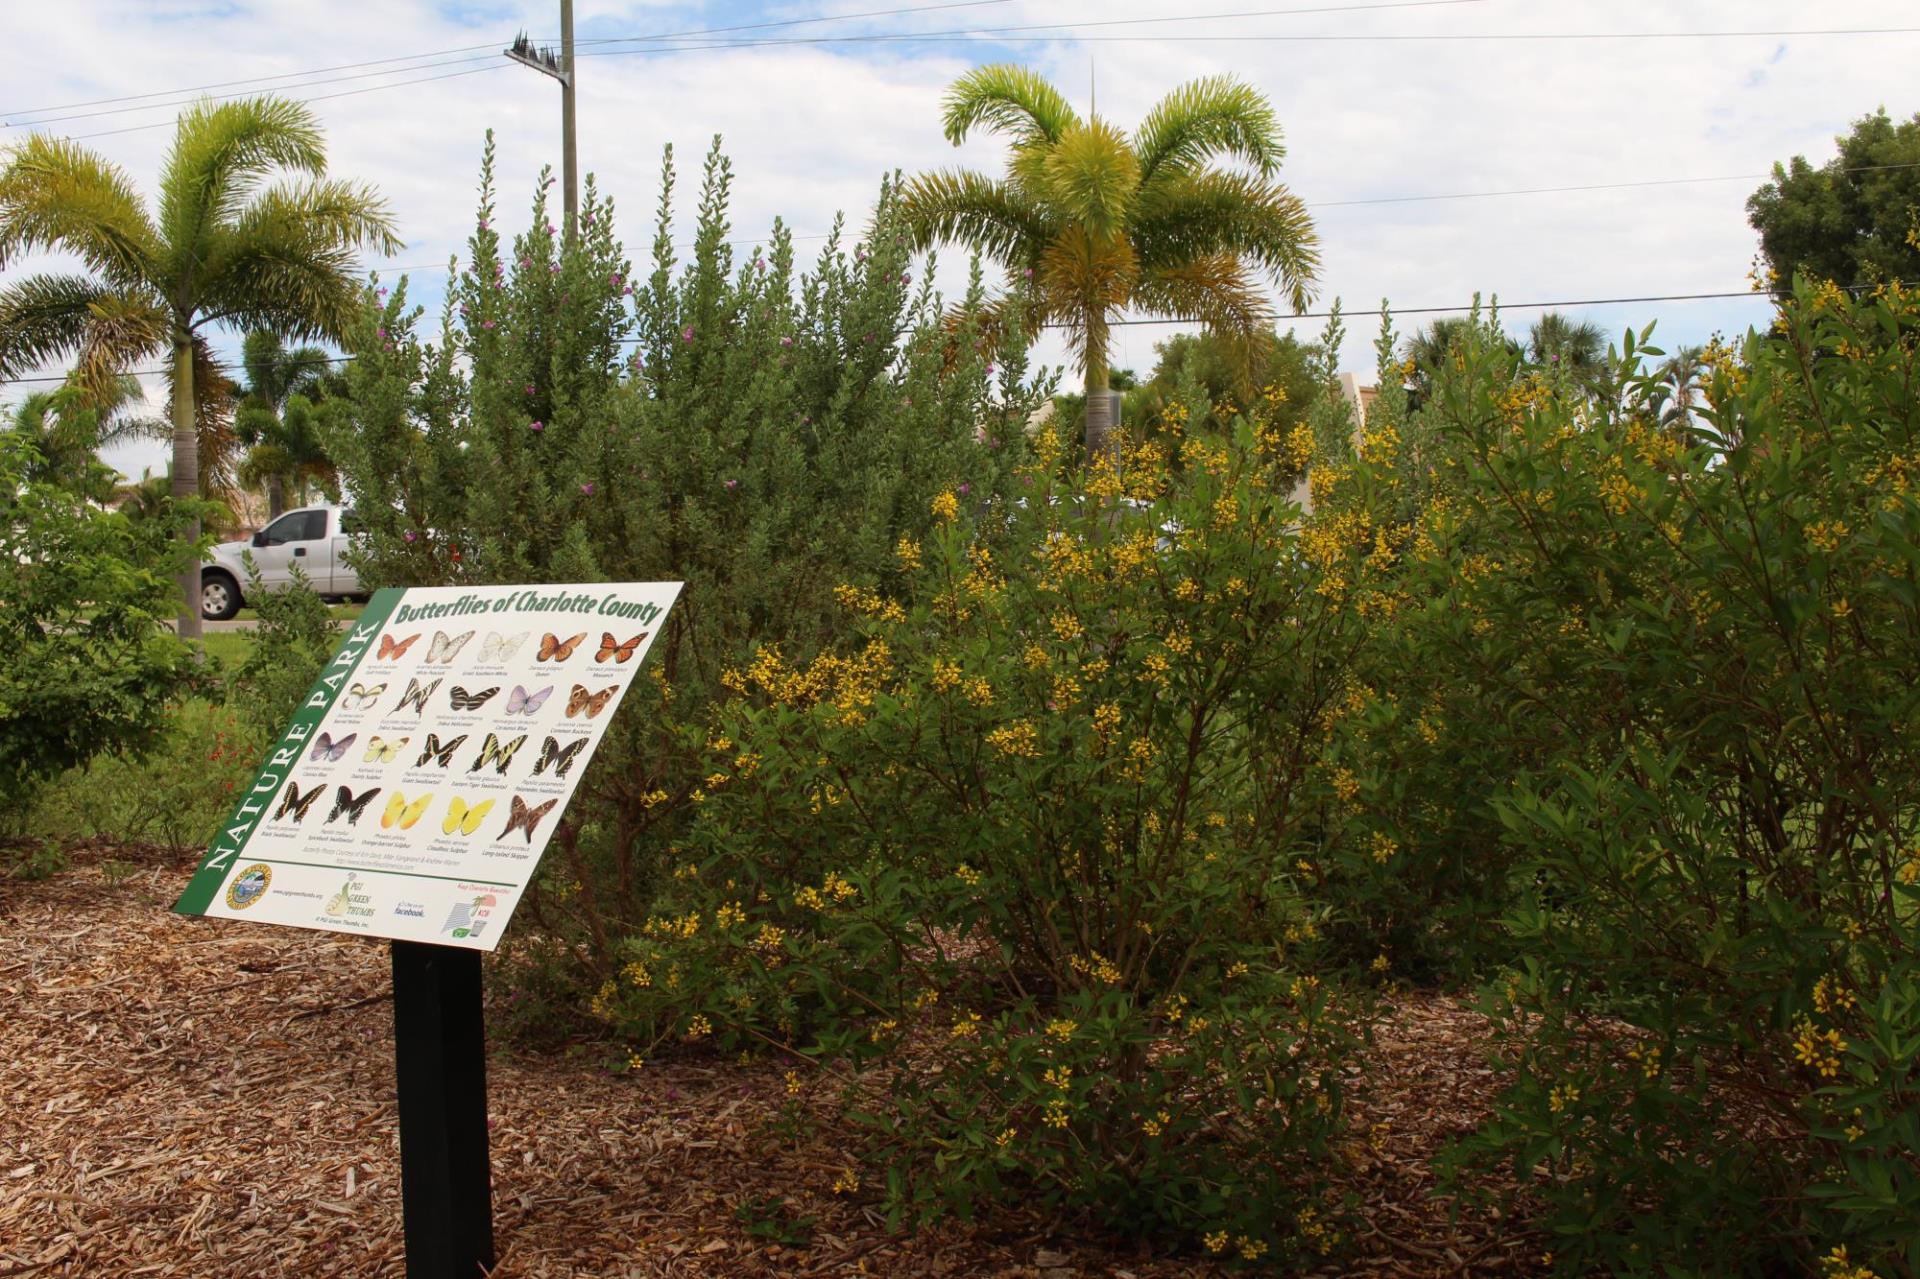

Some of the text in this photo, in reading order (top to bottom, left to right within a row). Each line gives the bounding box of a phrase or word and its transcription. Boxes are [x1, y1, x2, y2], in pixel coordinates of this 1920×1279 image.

[395, 590, 663, 626] Butterflies of Charlotte County
[205, 620, 380, 872] NATURE PARK
[351, 882, 363, 891] PGI
[349, 894, 371, 904] GREEN
[347, 906, 375, 917] THUMBS
